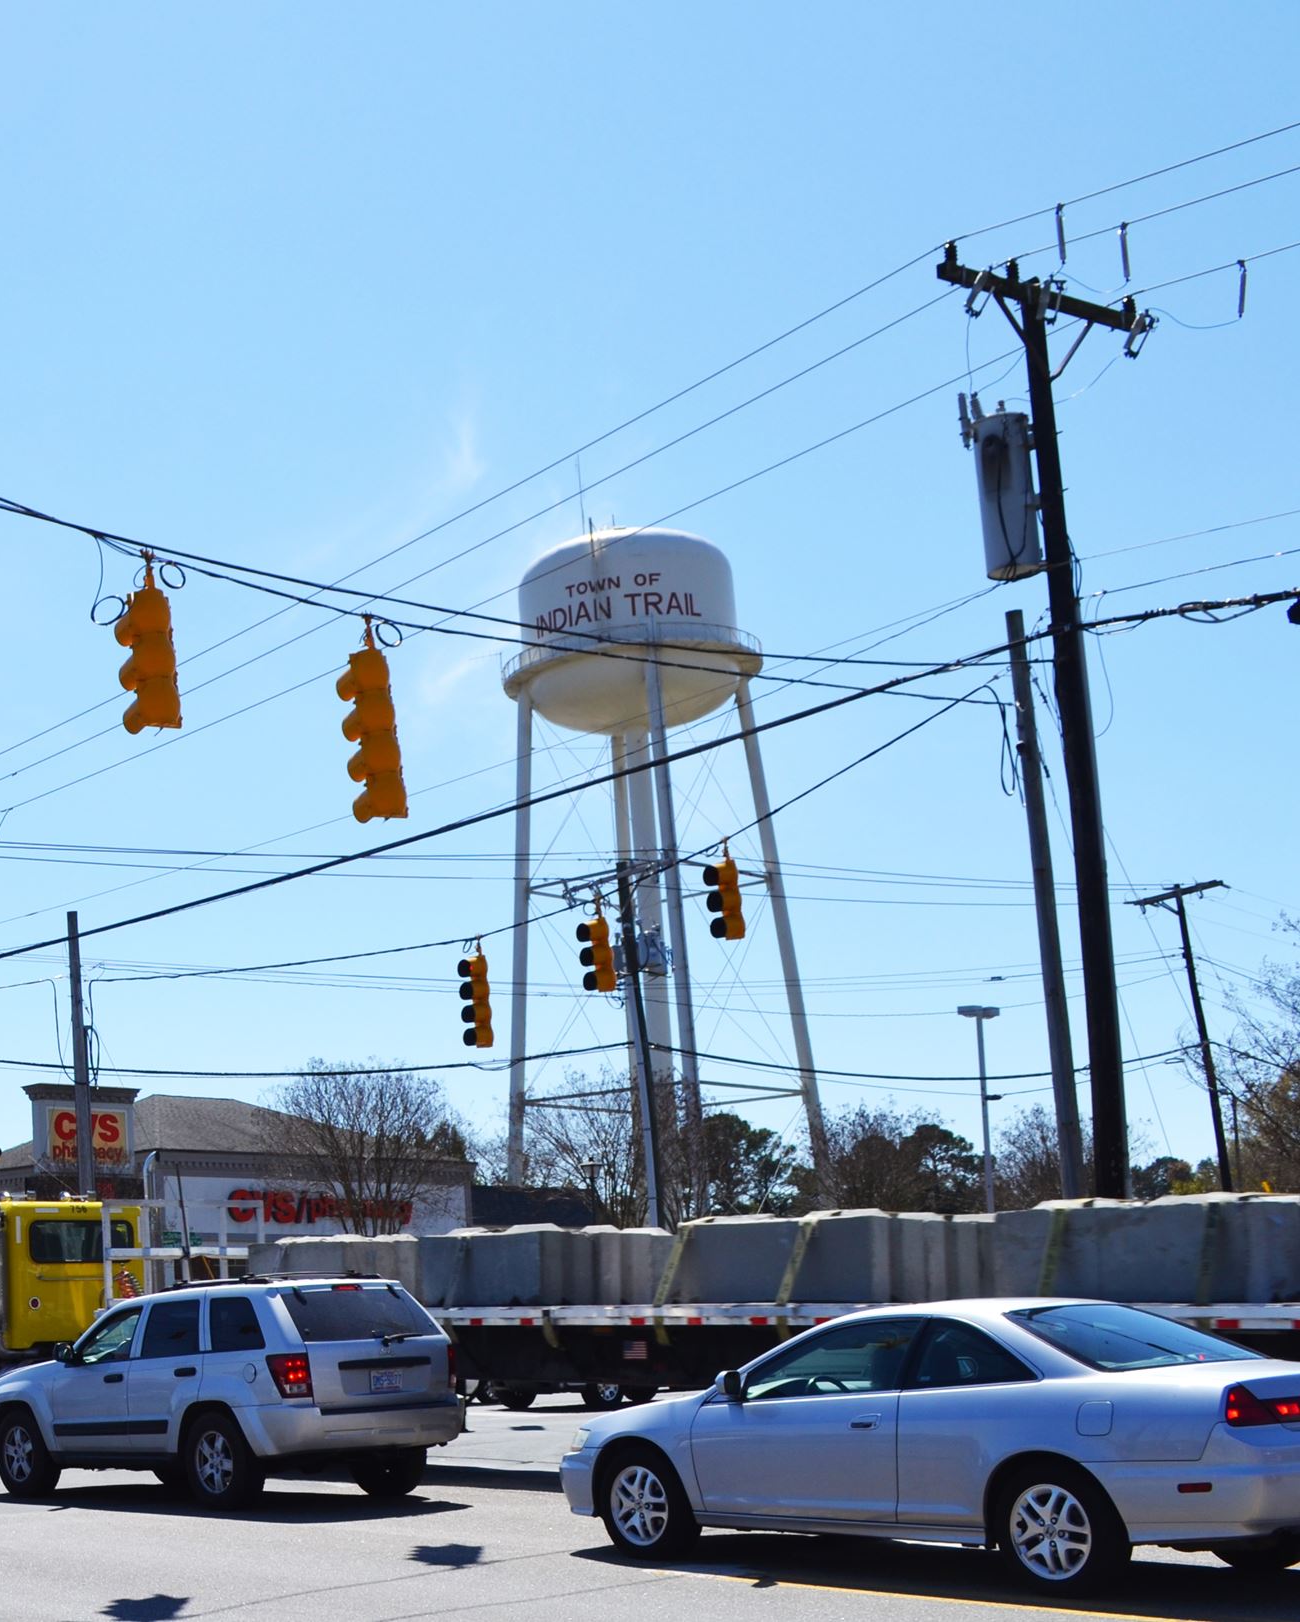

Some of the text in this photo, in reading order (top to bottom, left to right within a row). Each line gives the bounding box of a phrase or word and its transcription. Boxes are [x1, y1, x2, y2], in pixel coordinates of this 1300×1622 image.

[565, 573, 661, 598] TOWN OF
[536, 592, 702, 639] INDIAN TRAIL
[53, 1142, 124, 1162] phaacy
[228, 1189, 413, 1224] CVS/phay
